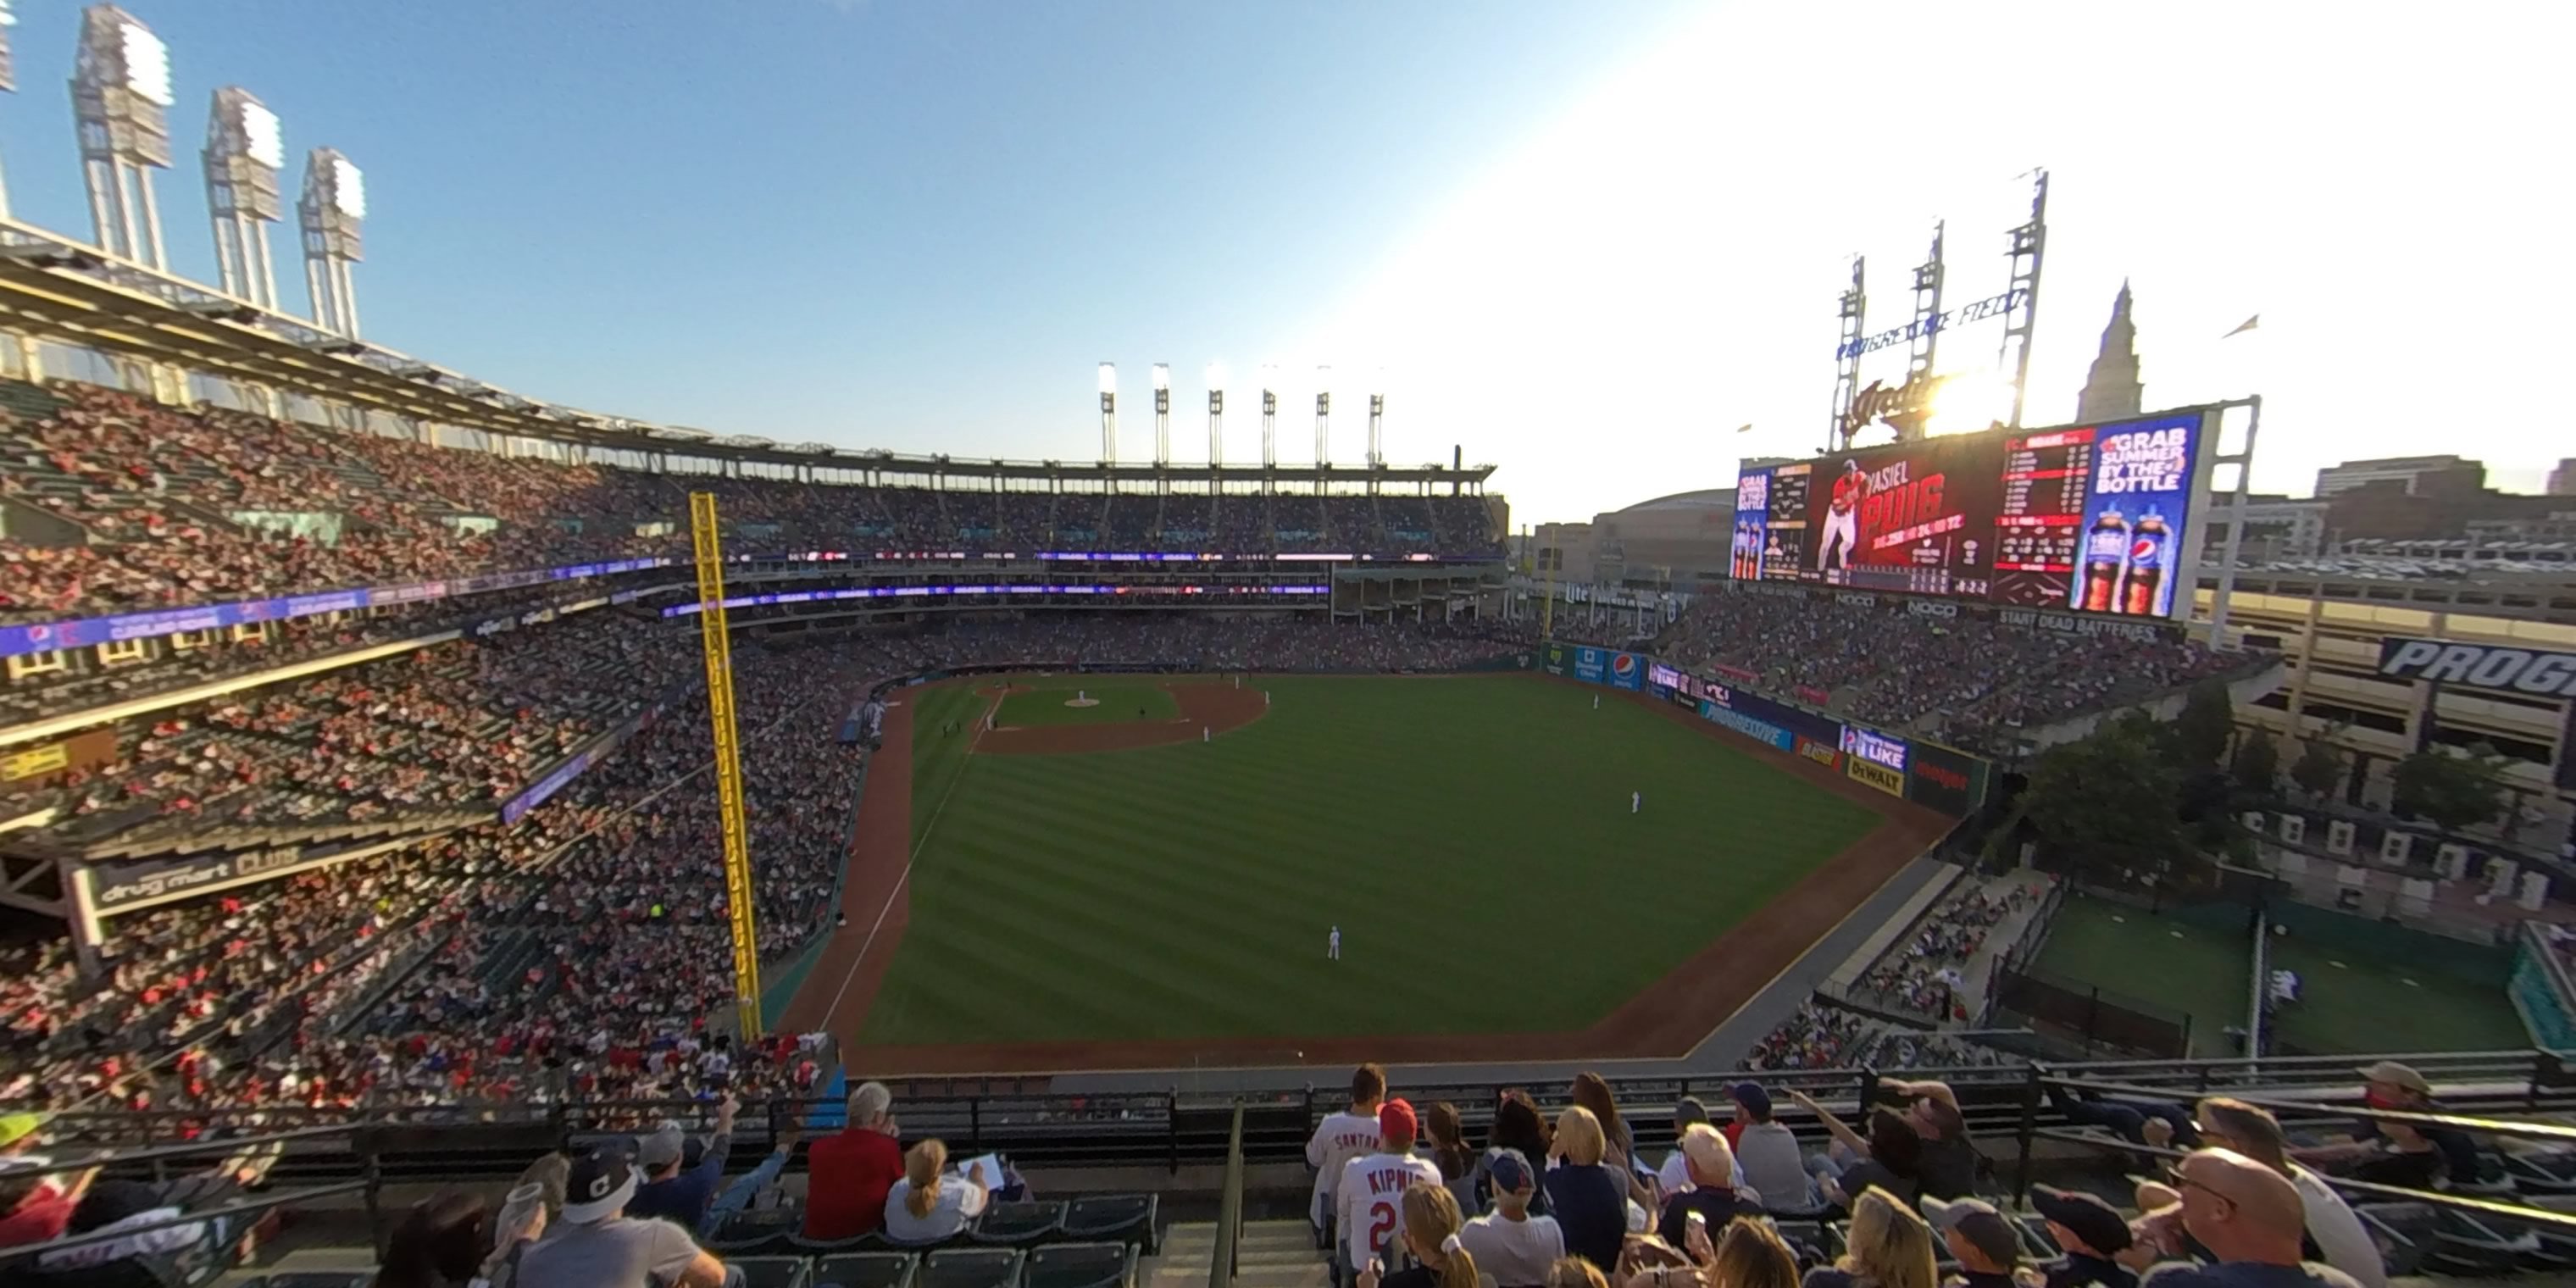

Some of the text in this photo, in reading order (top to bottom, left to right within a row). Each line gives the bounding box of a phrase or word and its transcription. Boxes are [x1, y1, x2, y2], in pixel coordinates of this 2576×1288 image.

[2114, 427, 2187, 452] GRAB
[2101, 446, 2185, 465] SUMMER
[1867, 460, 1908, 498] YASIEL
[2098, 461, 2166, 480] BY THE
[2096, 474, 2181, 494] BOTTLE
[1862, 473, 1945, 538] PUIG
[1907, 600, 1957, 618] NOCO
[2000, 609, 2035, 625] START
[2038, 613, 2075, 630] DEAD
[1868, 745, 1904, 769] LIKE
[102, 877, 165, 903] drug
[167, 863, 229, 888] mart
[1335, 1132, 1381, 1151] SANTAN
[590, 1174, 610, 1198] C
